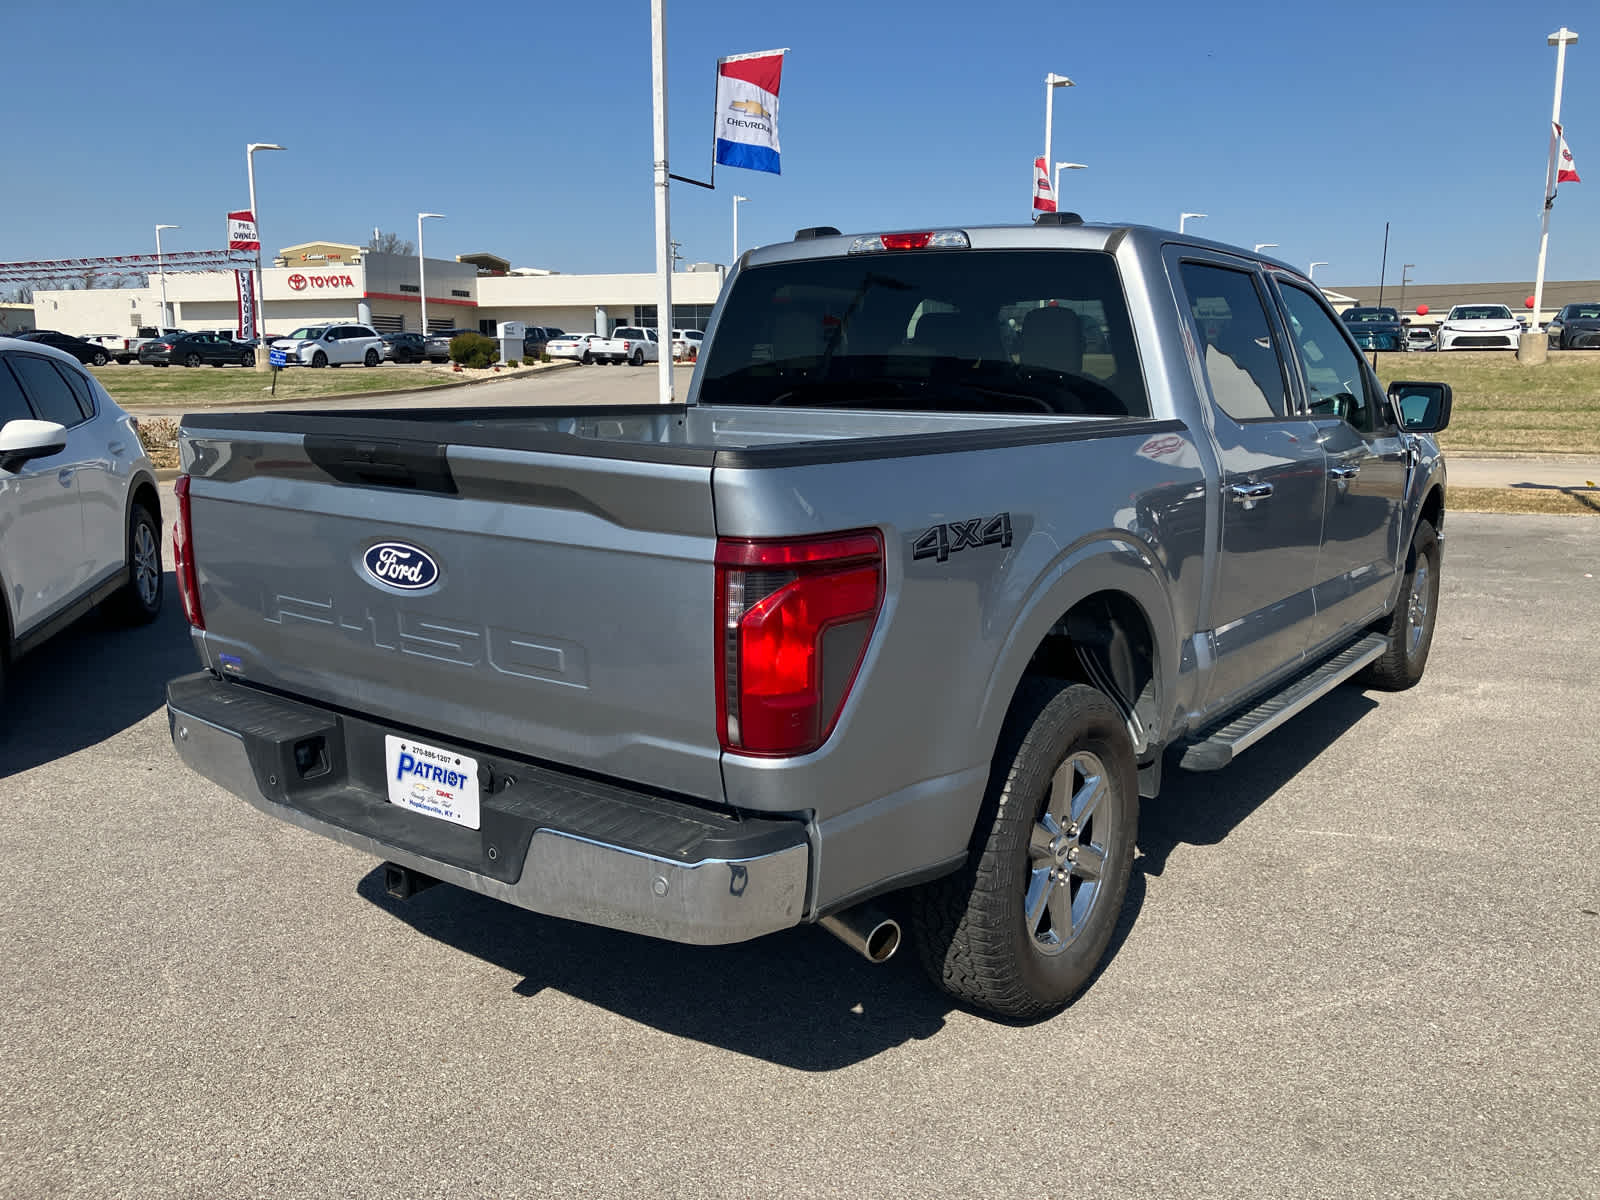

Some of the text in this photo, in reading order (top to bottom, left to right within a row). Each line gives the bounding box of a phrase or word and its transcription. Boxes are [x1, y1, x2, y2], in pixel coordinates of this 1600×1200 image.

[308, 275, 354, 288] TOYOTA
[376, 547, 423, 583] Ford
[262, 590, 591, 690] F-150
[397, 752, 468, 790] PATRIOT
[435, 789, 454, 800] GMC
[444, 810, 453, 818] KY
